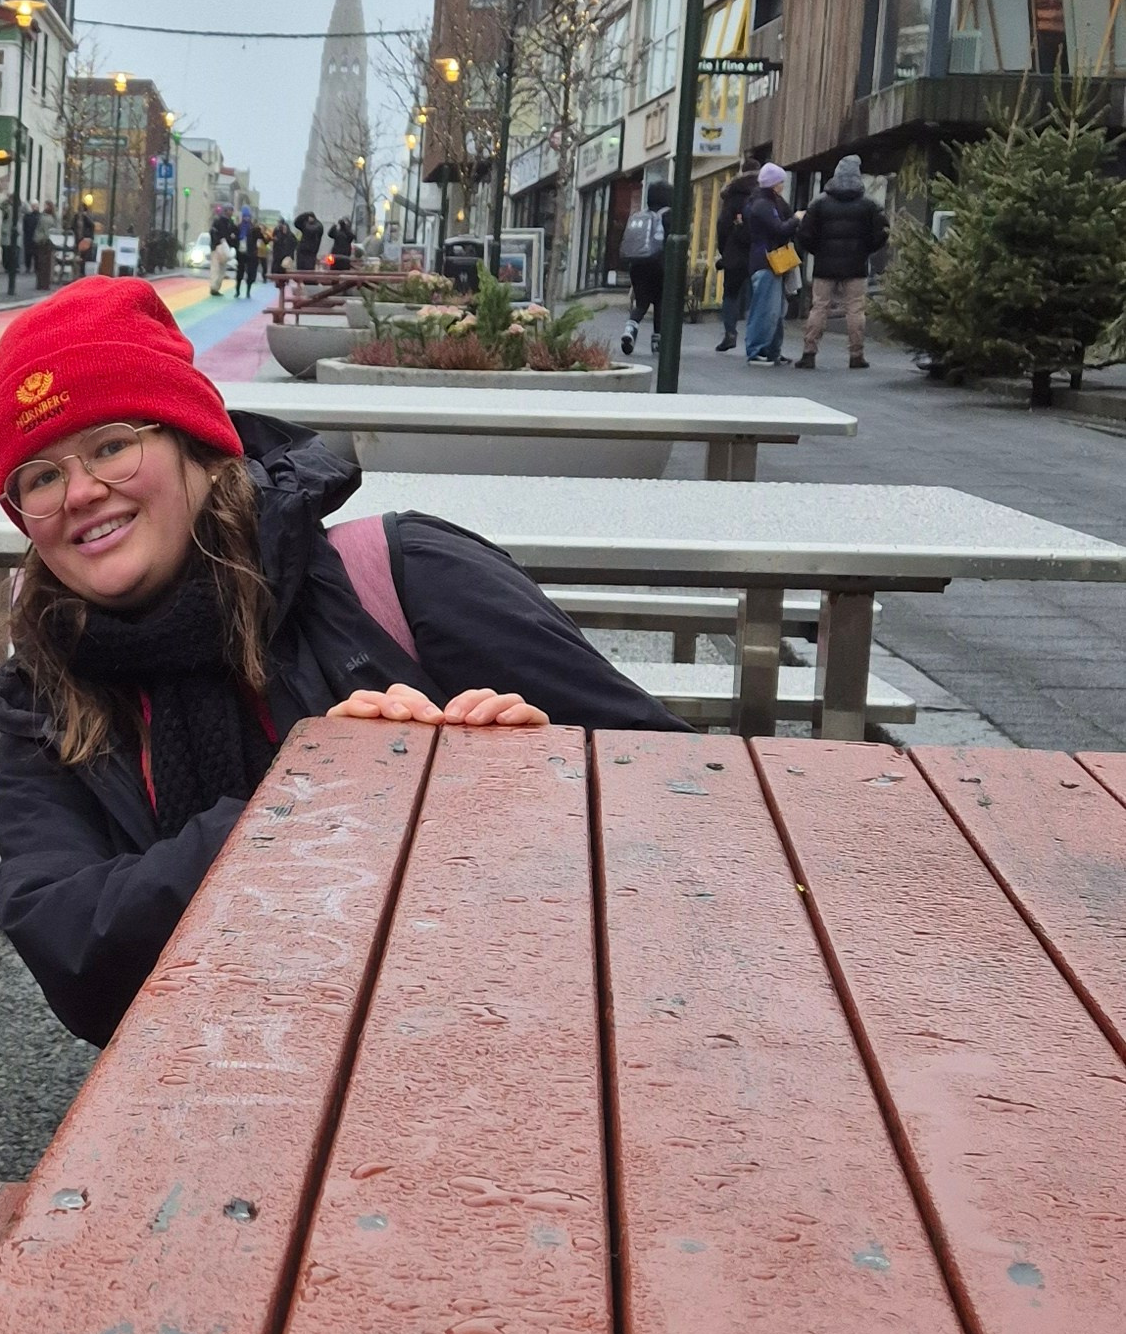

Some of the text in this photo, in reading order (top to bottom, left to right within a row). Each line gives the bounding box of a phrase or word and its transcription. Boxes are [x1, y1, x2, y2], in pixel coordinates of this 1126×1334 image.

[697, 59, 713, 71] rie
[721, 59, 745, 71] fine
[746, 61, 764, 71] art
